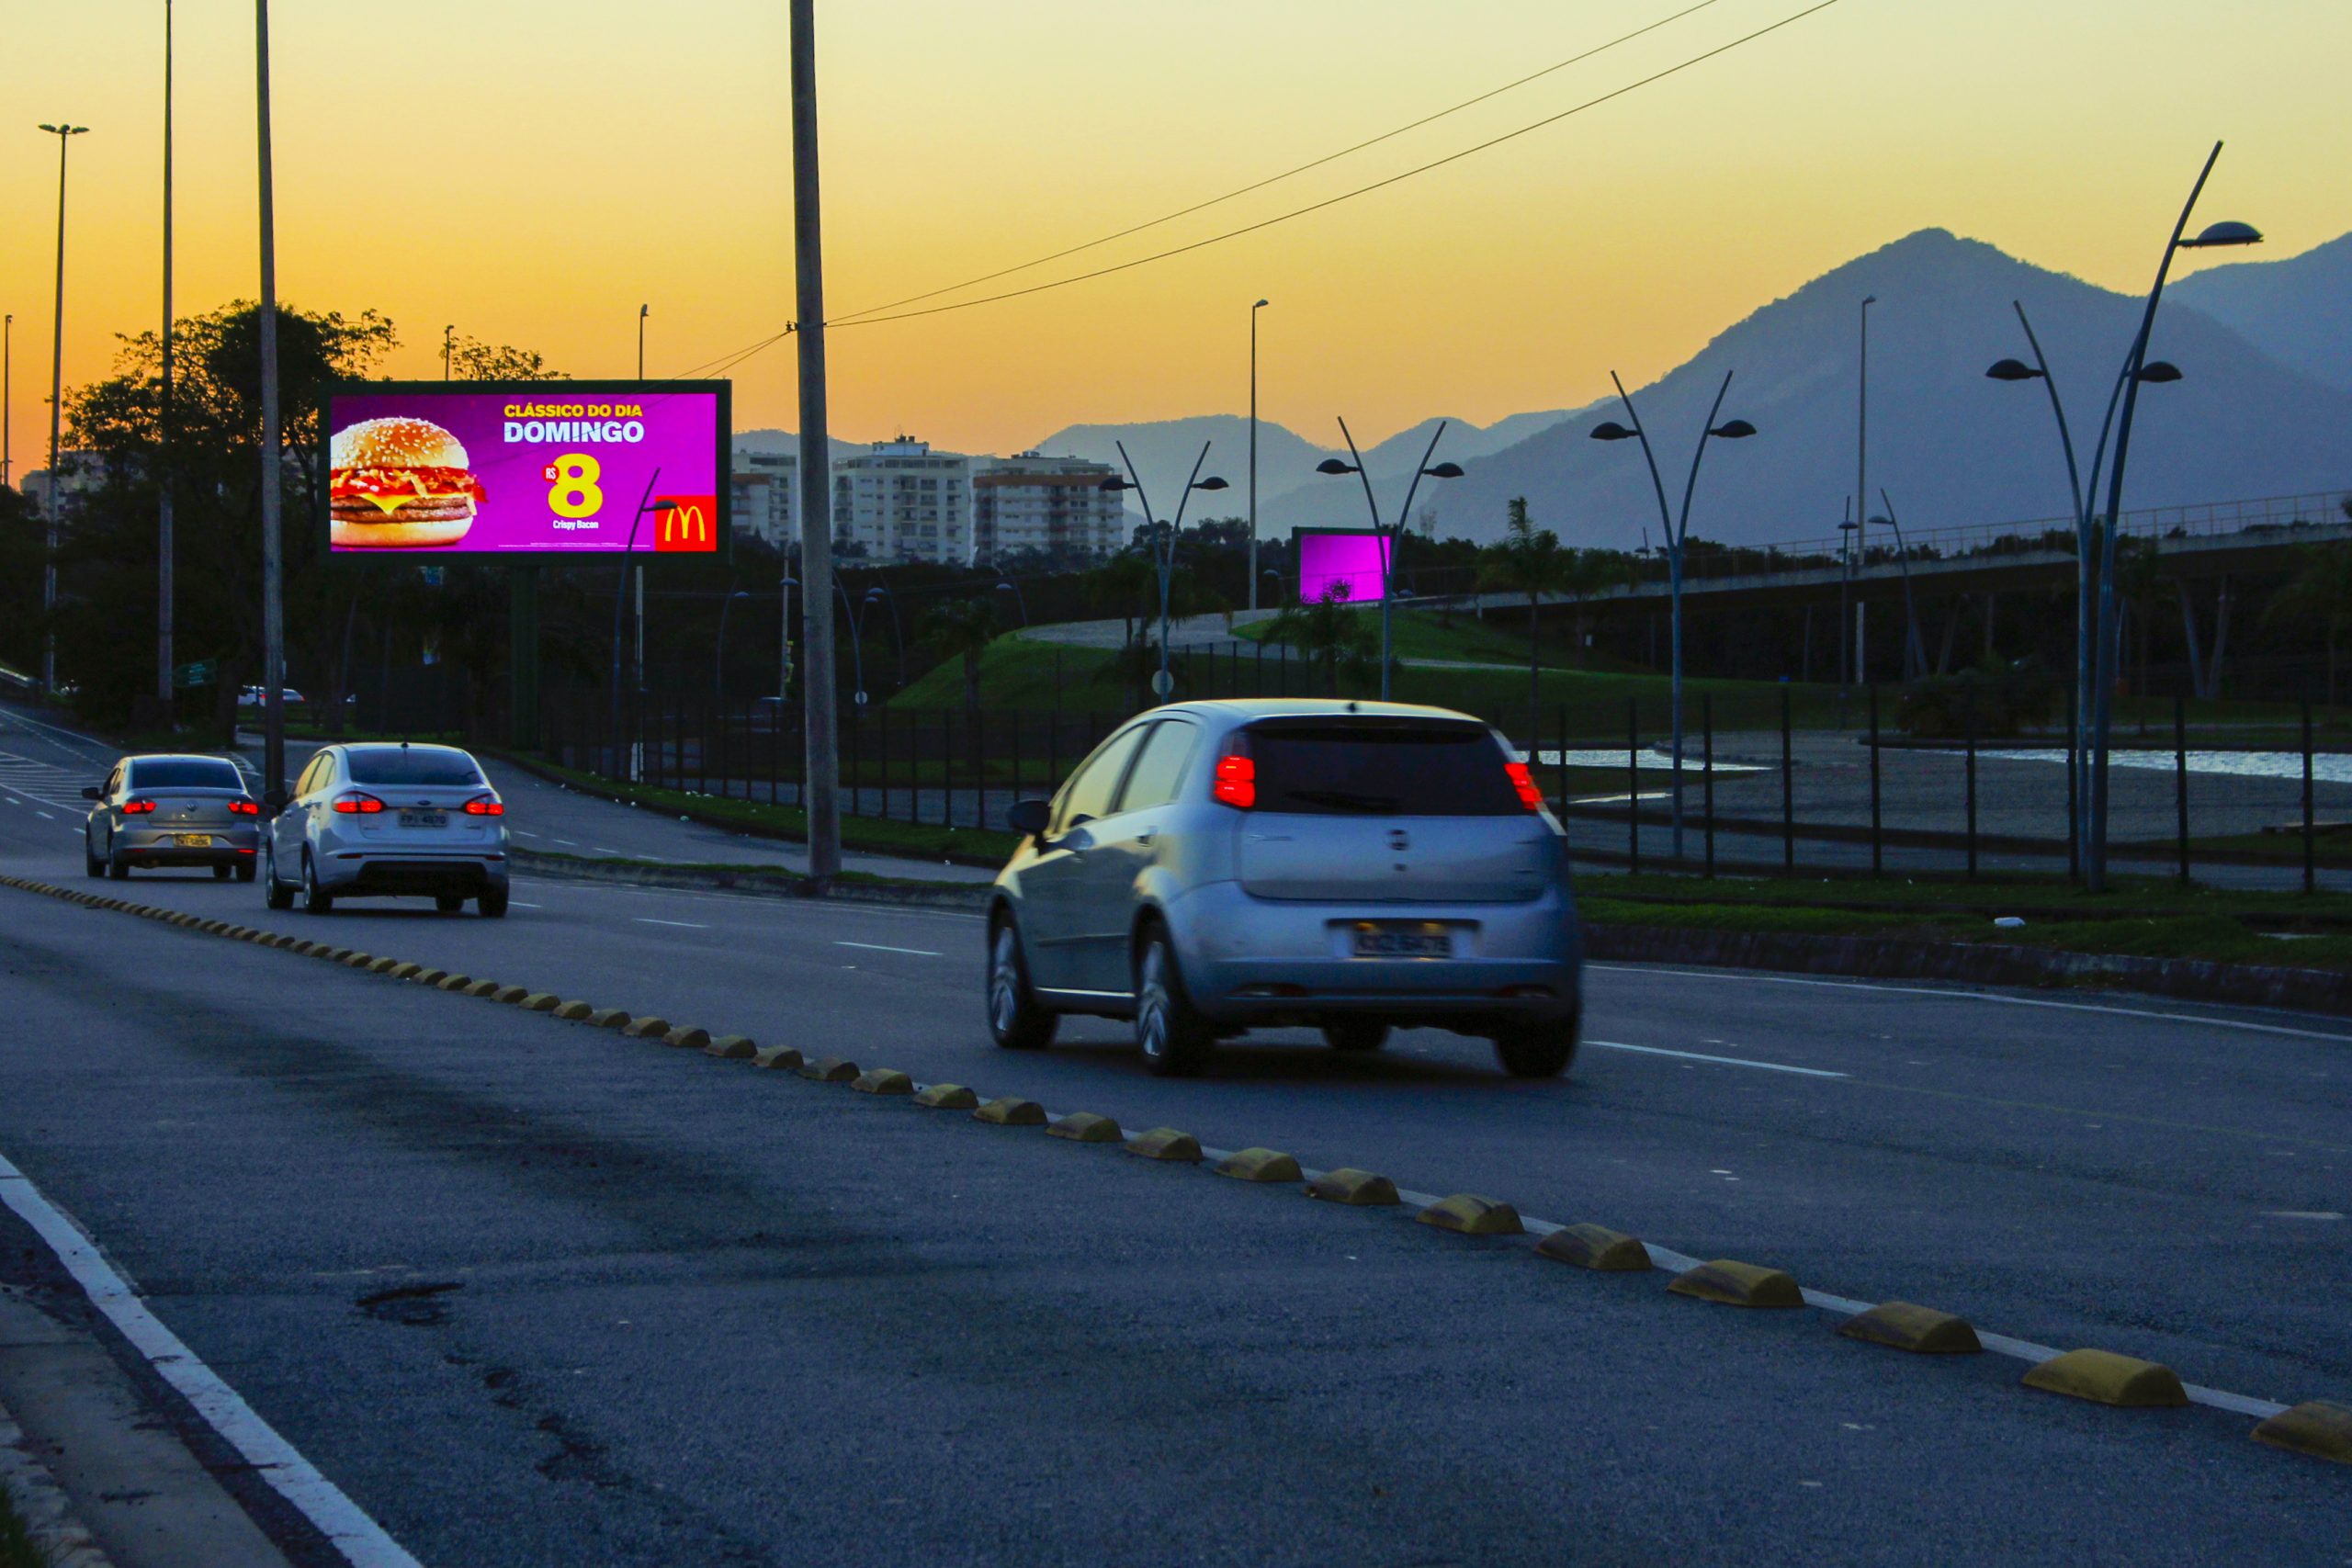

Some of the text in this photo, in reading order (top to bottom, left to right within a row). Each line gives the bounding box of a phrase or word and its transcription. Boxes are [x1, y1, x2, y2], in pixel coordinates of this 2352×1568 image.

[504, 402, 643, 418] CLÁSSICO DO DIA
[503, 421, 645, 443] DOMINGO
[548, 453, 603, 518] 8
[553, 520, 599, 530] Crispy Bacon
